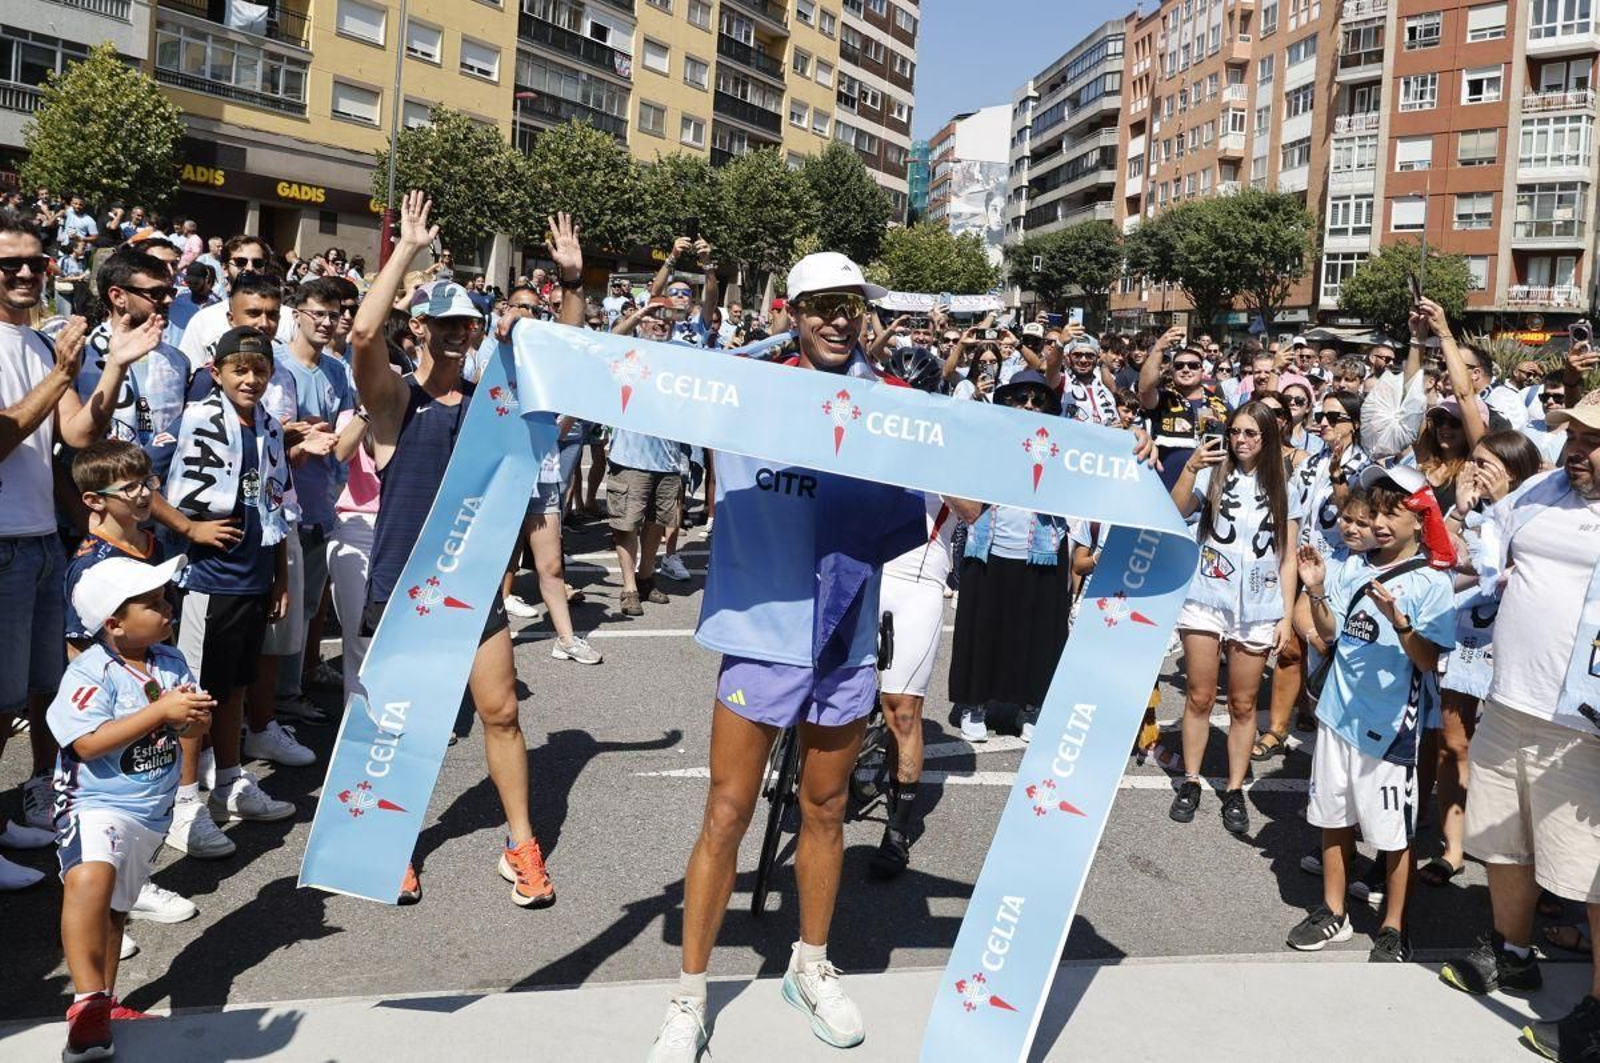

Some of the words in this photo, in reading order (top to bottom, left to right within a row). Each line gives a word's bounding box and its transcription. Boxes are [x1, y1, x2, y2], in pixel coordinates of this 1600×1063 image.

[181, 165, 225, 186] ADIS
[277, 182, 325, 203] GADIS
[656, 372, 740, 408] CELTA
[866, 411, 945, 448] CELTA
[1064, 449, 1140, 482] CELTA
[755, 467, 818, 499] CITR
[436, 495, 484, 573] CELTA
[365, 701, 411, 778] CELTA
[1051, 702, 1096, 778] CELTA
[133, 753, 173, 772] Galicia
[1380, 786, 1400, 812] 11
[982, 895, 1025, 973] CELTA
